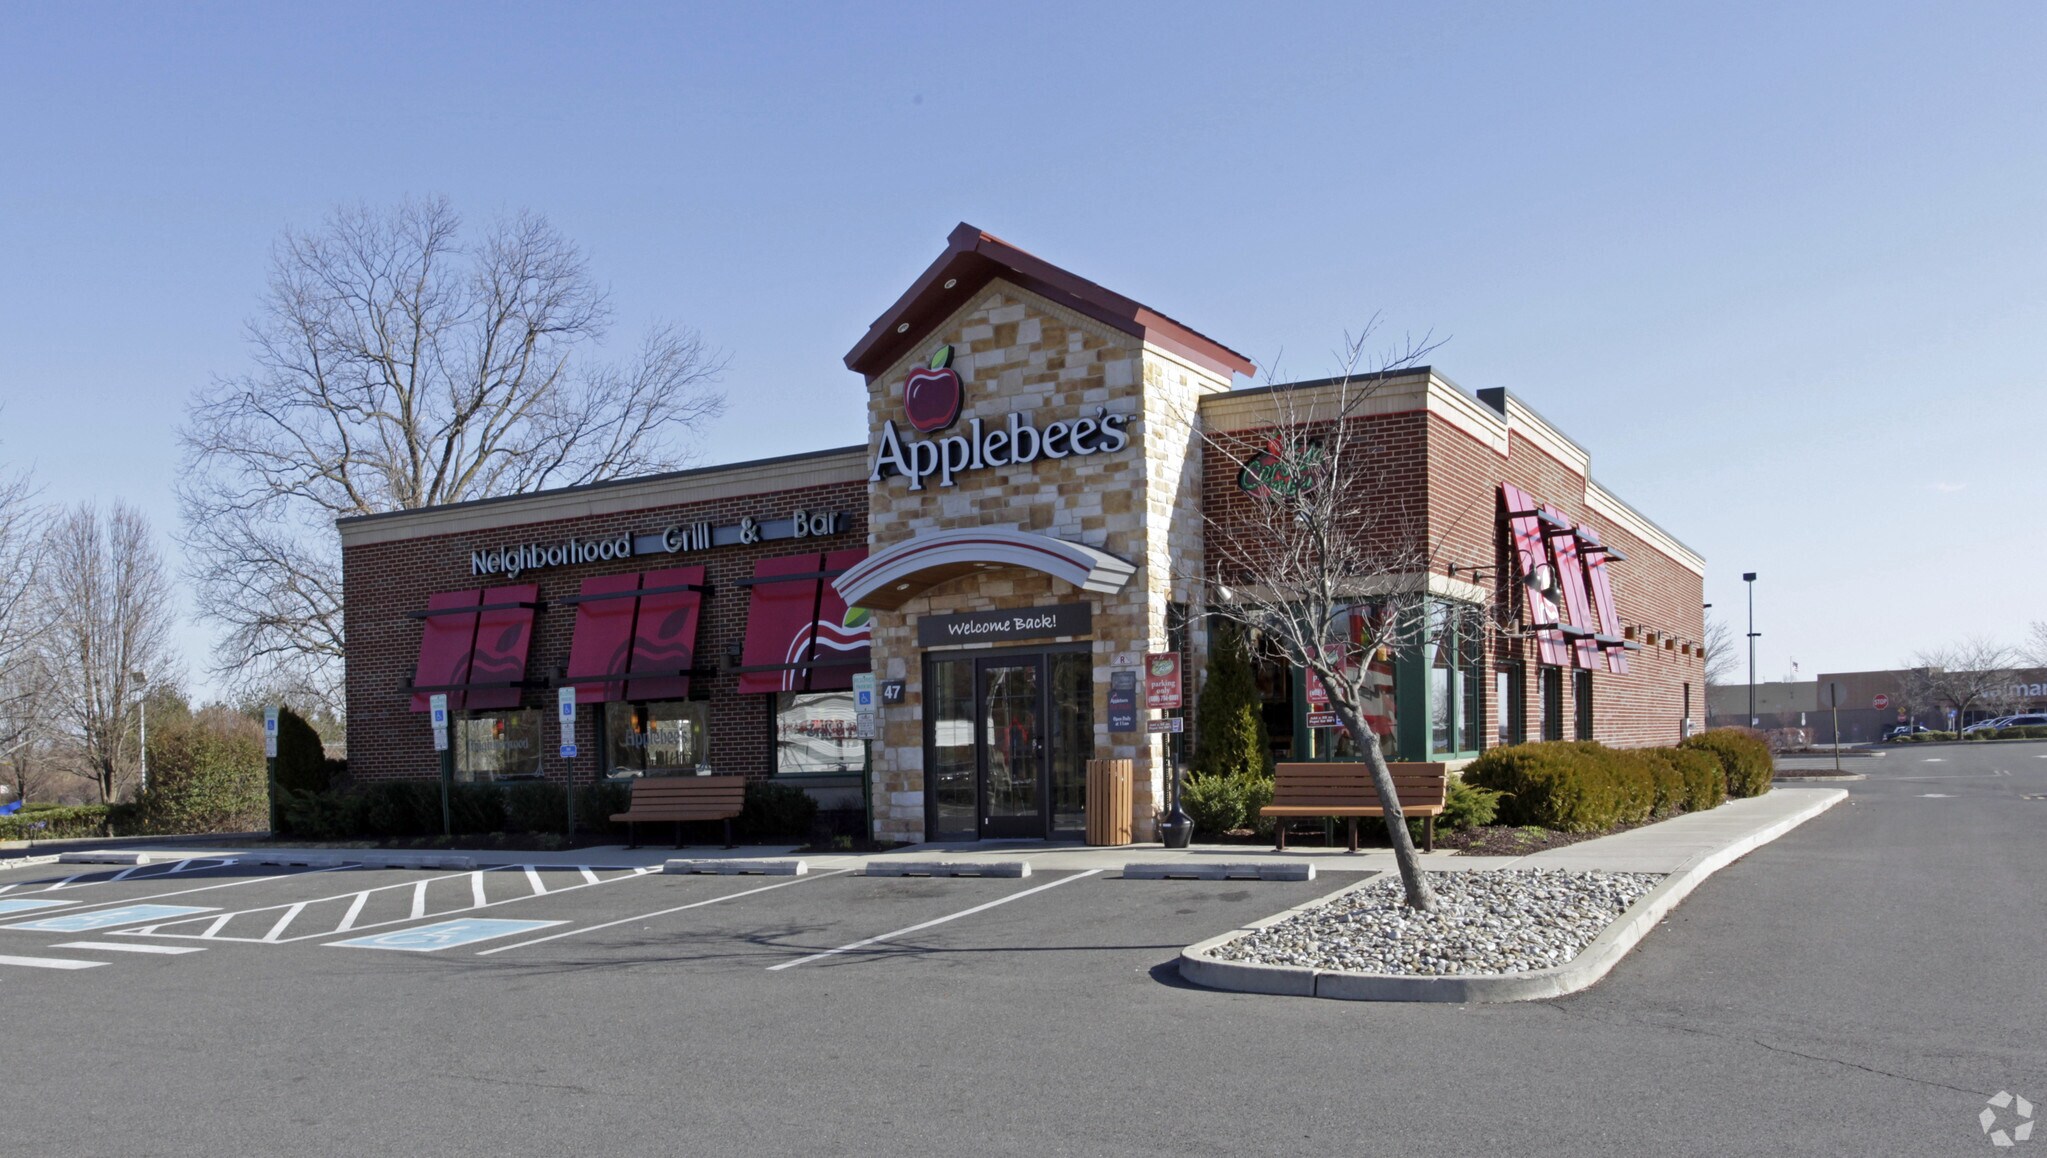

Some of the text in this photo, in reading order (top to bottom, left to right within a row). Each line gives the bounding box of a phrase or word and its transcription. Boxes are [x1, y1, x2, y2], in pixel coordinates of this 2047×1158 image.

[869, 406, 1127, 491] Applebee's
[471, 509, 842, 580] Neighborhood Grill & Bar
[948, 614, 1057, 636] Welcome Back!
[1120, 655, 1125, 663] R
[1151, 680, 1176, 689] parking
[1156, 686, 1171, 695] only
[884, 685, 901, 699] 47
